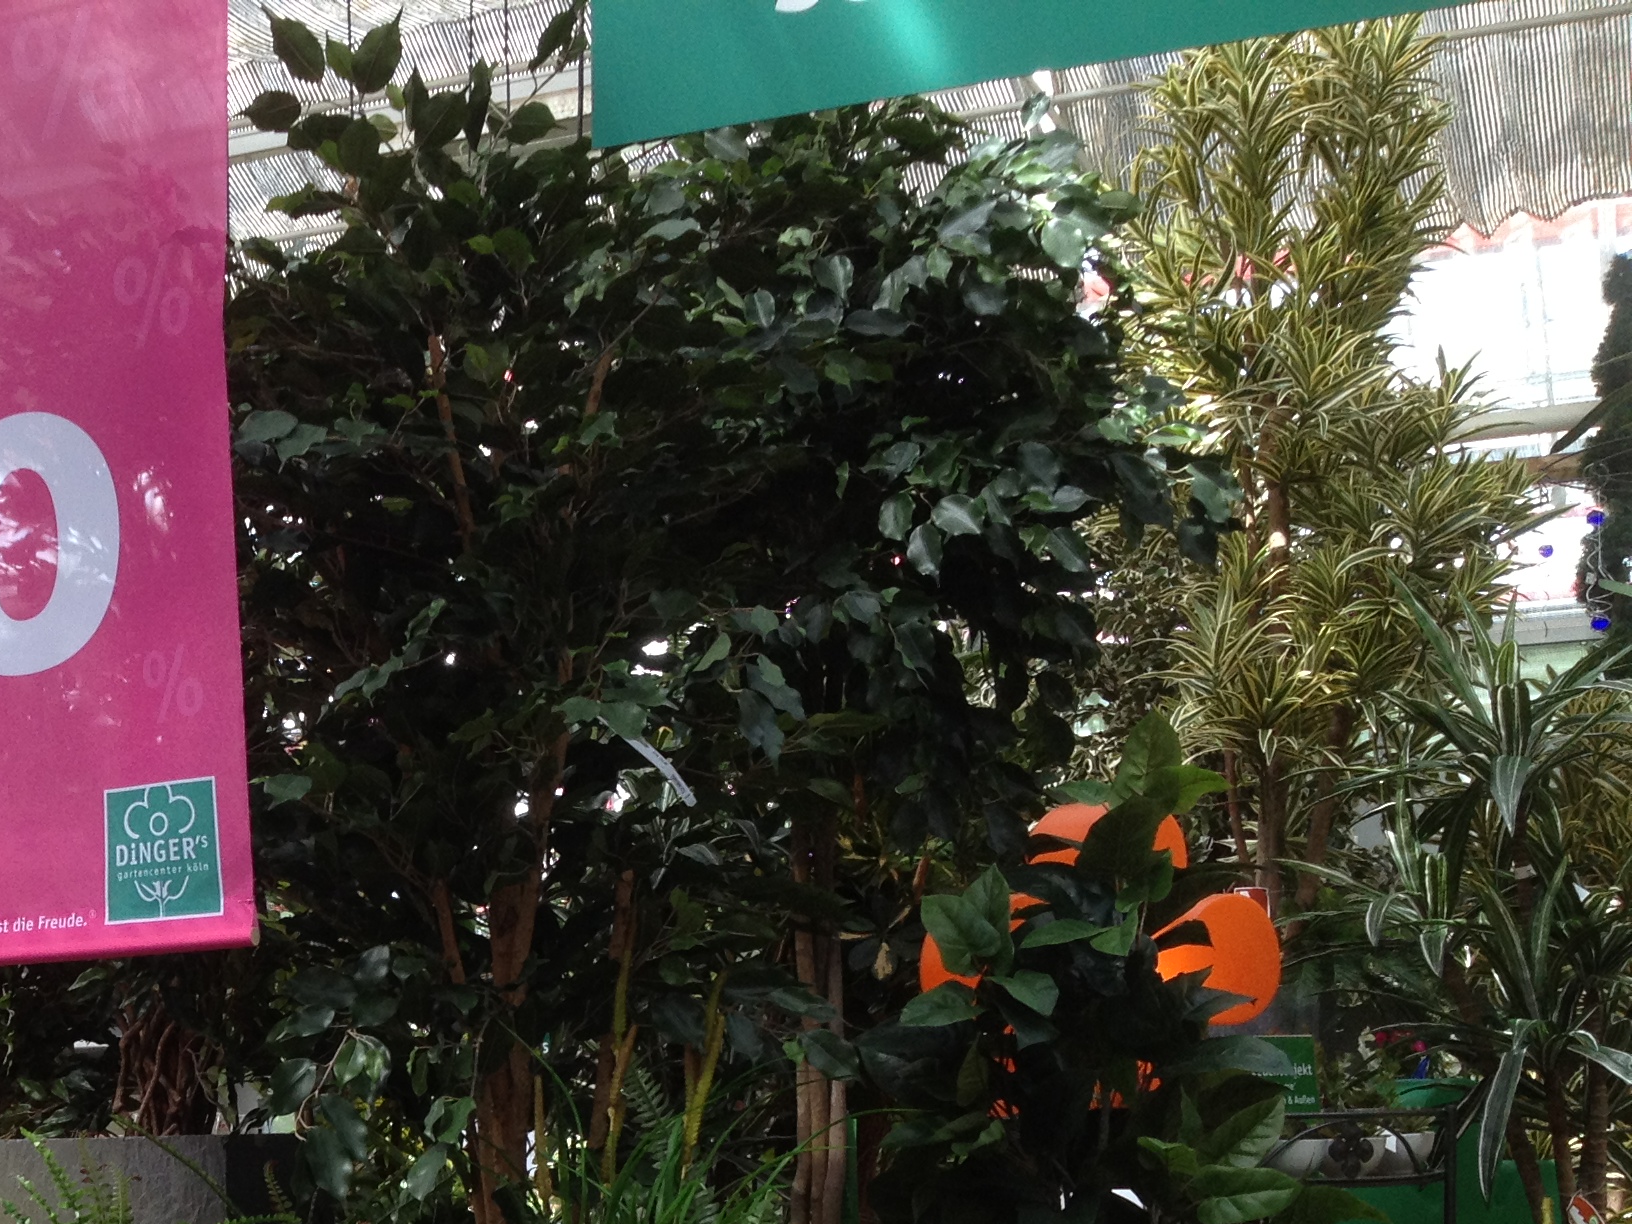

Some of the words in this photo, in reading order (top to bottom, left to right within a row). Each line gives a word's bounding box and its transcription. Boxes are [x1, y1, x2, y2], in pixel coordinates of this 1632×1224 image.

[117, 865, 183, 881] gartencenter
[186, 861, 209, 873] köln
[12, 917, 34, 932] die
